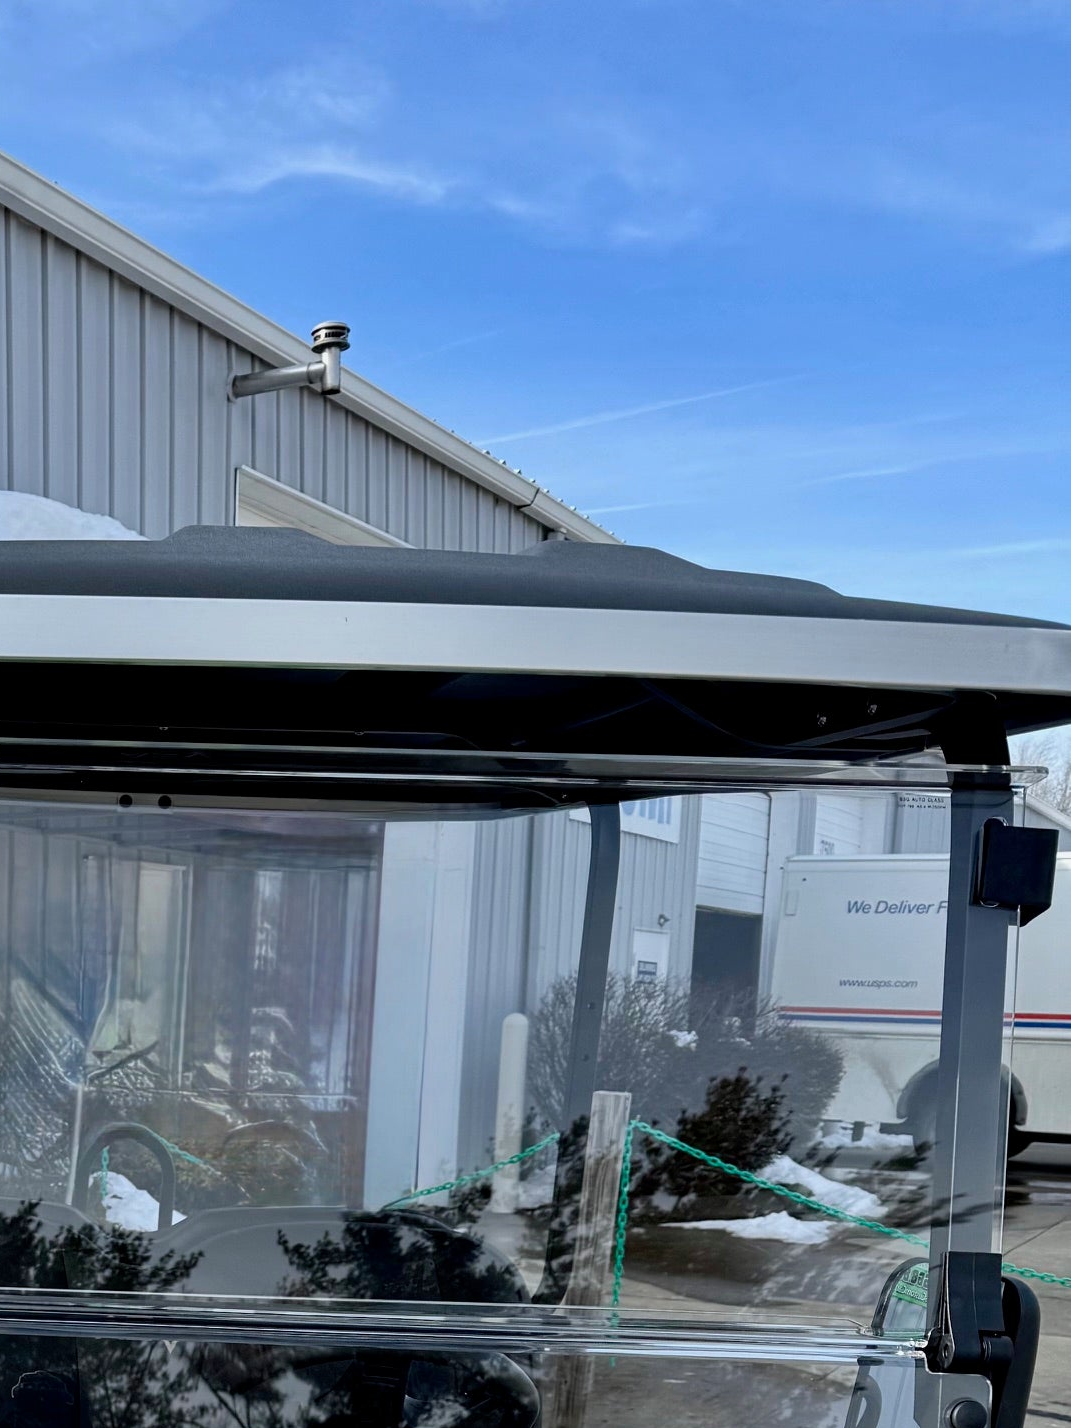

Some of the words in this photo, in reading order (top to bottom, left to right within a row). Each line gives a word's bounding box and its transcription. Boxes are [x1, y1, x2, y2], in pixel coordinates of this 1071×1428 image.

[847, 900, 872, 914] We
[874, 900, 934, 914] Deliver
[839, 979, 918, 989] www.usps.com
